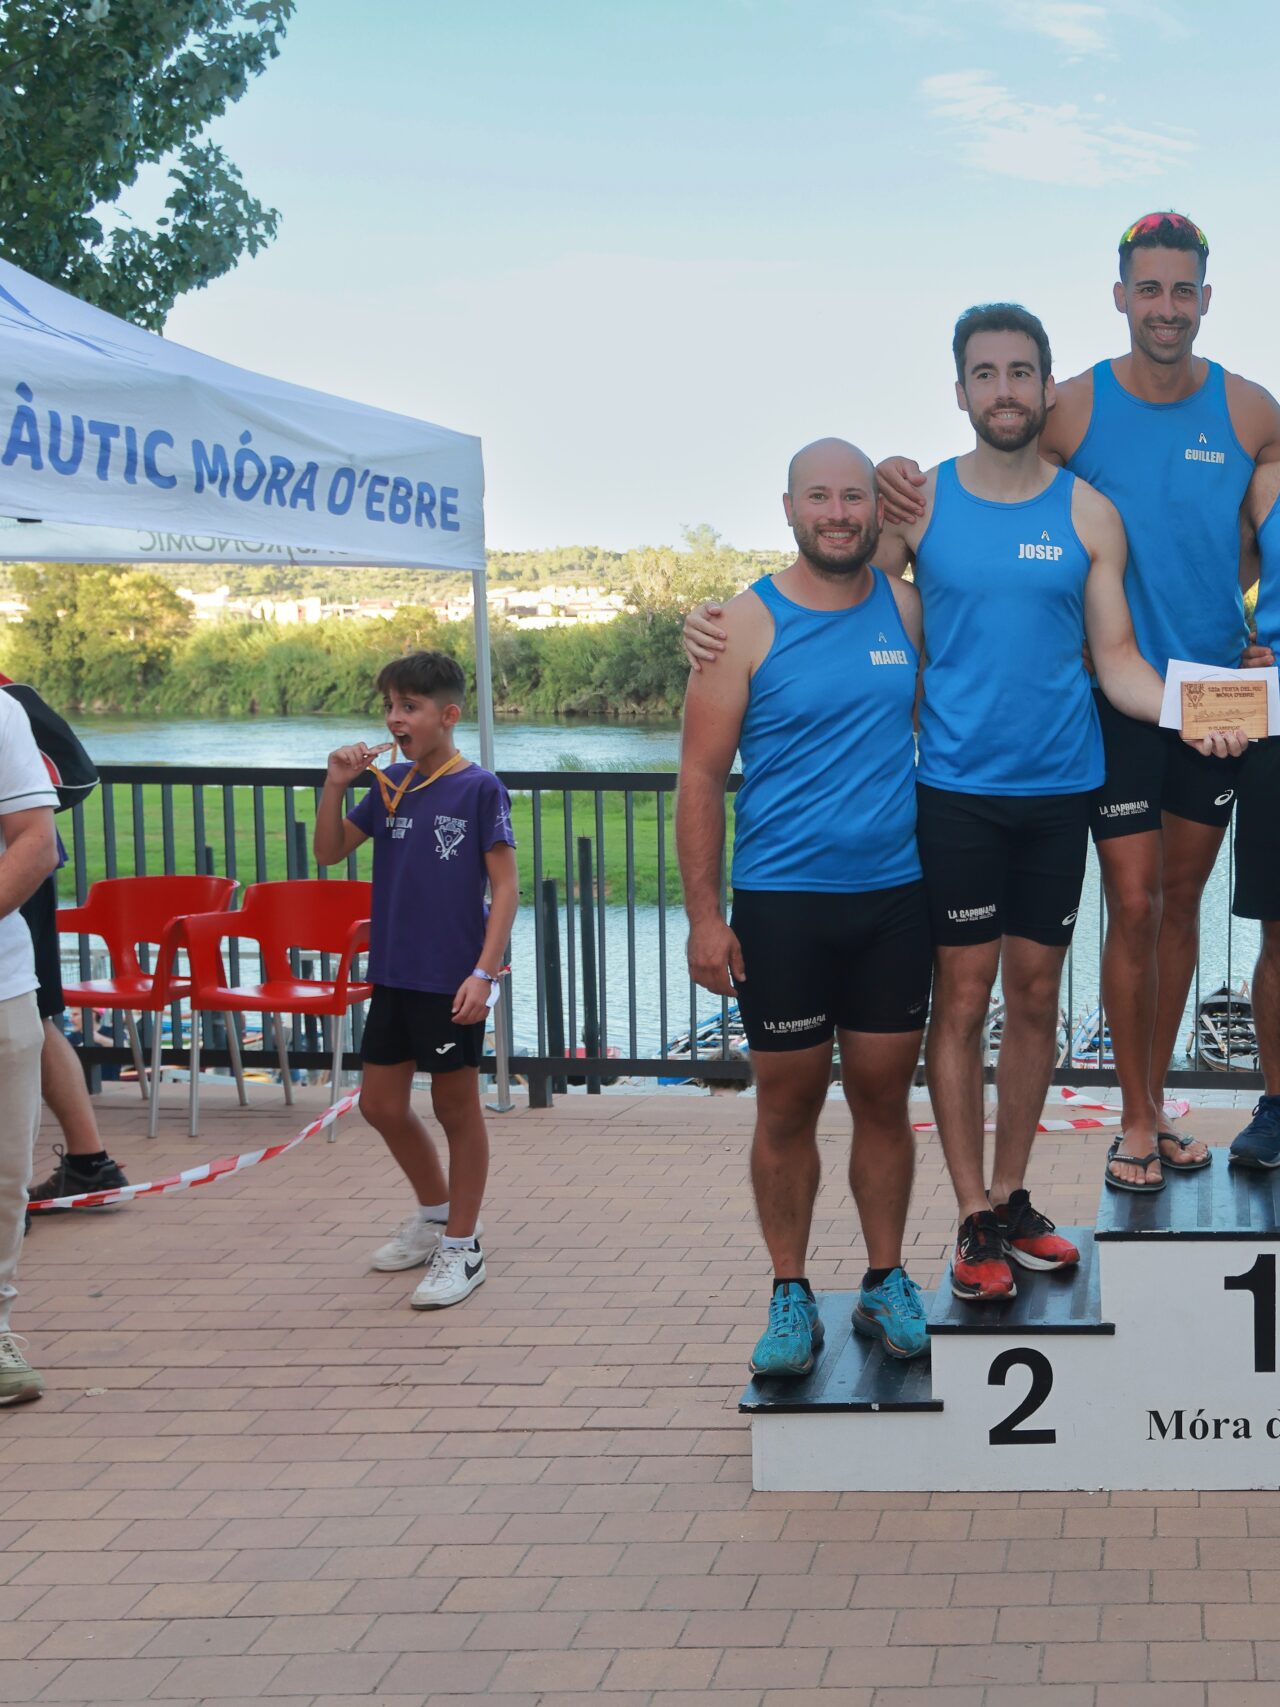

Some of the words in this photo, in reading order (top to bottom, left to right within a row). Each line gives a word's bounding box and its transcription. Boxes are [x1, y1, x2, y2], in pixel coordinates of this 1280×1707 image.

[1185, 448, 1225, 464] GUILLEM
[191, 430, 319, 512] MÓRA
[1018, 543, 1063, 561] JOSEP
[869, 650, 909, 665] MANEL
[1098, 805, 1109, 815] LA
[763, 1020, 776, 1030] LA
[1223, 1253, 1276, 1373] 1
[987, 1347, 1057, 1446] 2
[1146, 1408, 1252, 1441] Móra
